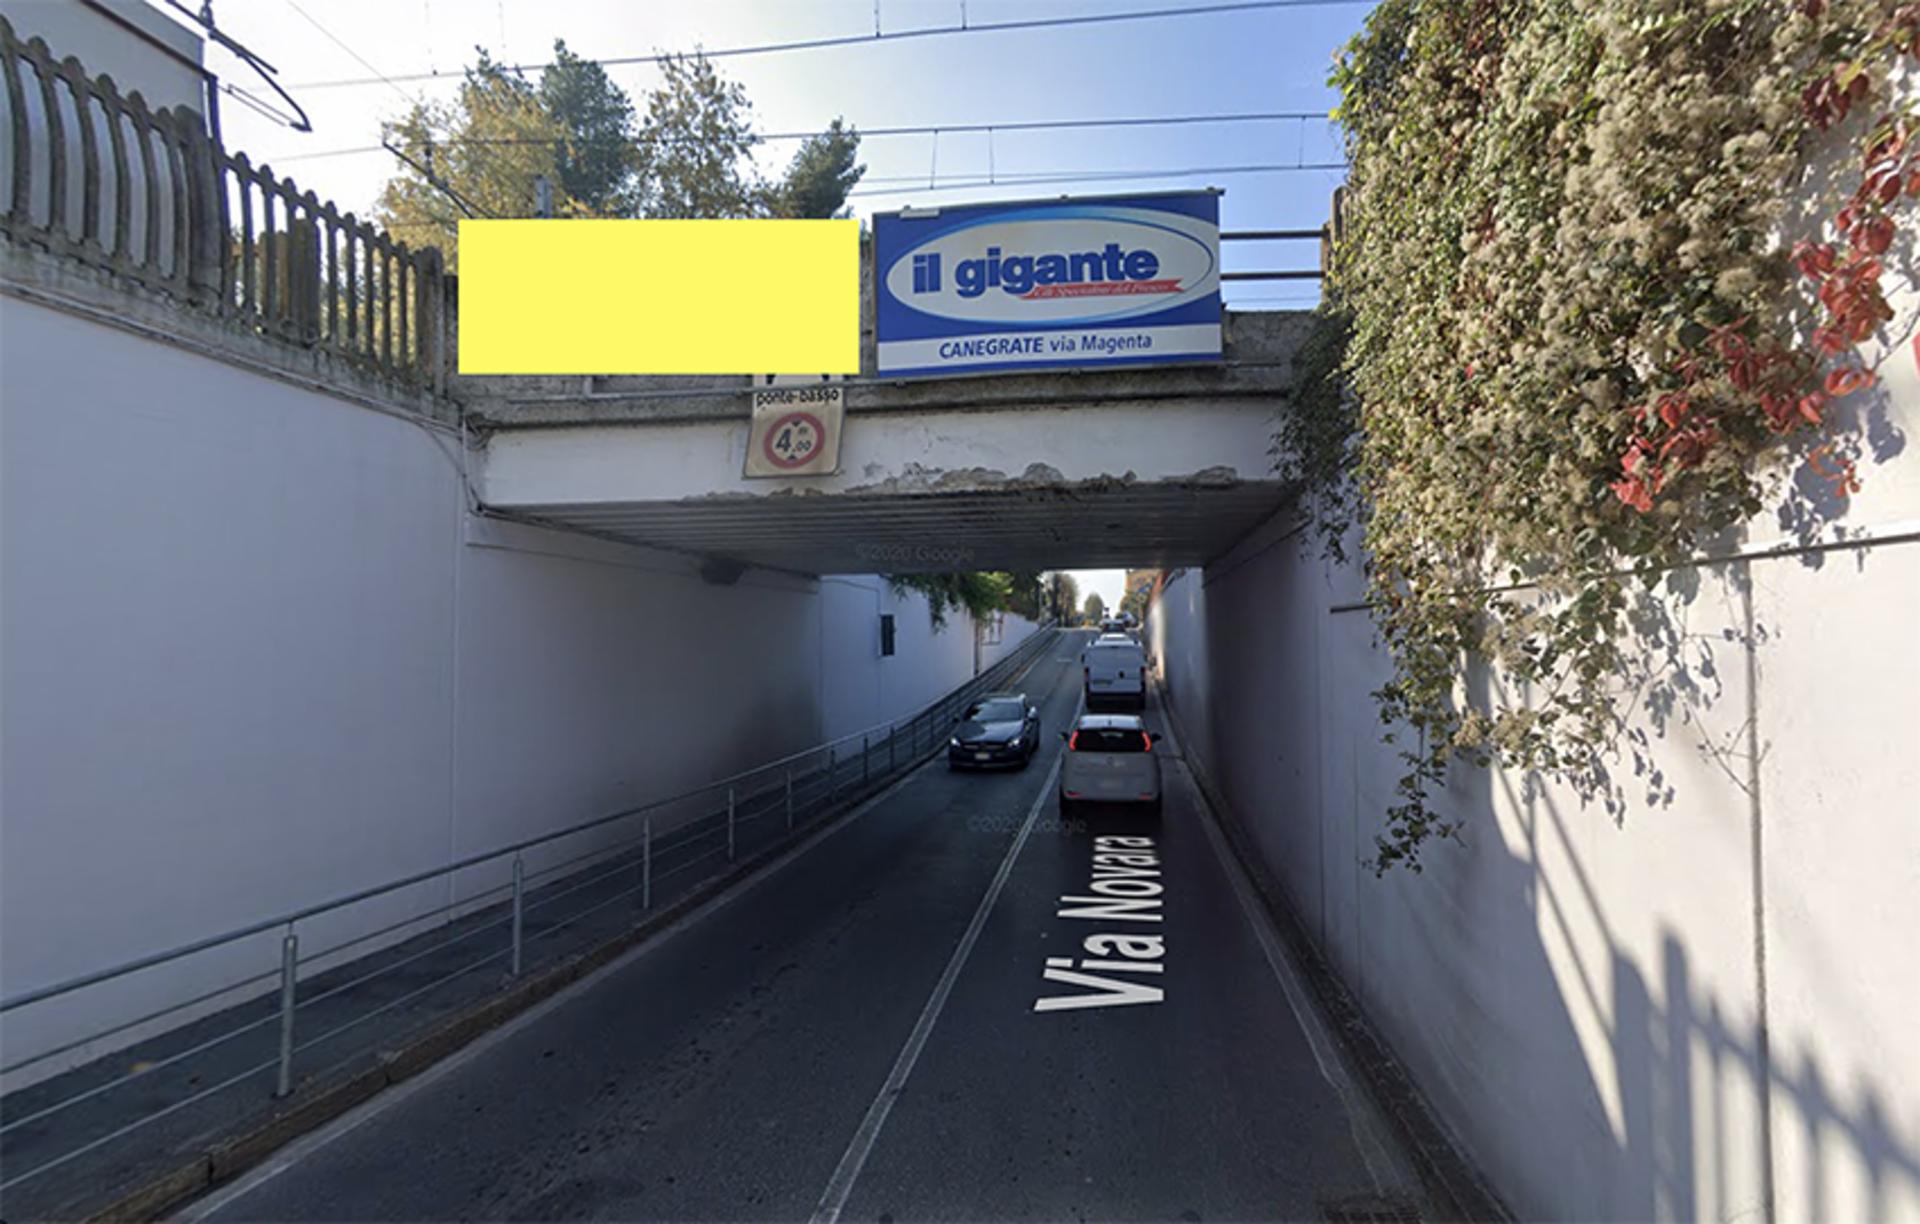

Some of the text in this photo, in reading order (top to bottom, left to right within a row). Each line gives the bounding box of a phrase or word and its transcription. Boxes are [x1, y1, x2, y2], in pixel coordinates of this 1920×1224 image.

[912, 243, 1160, 299] il gigante
[939, 333, 1152, 359] CANEGRATE via Magenta
